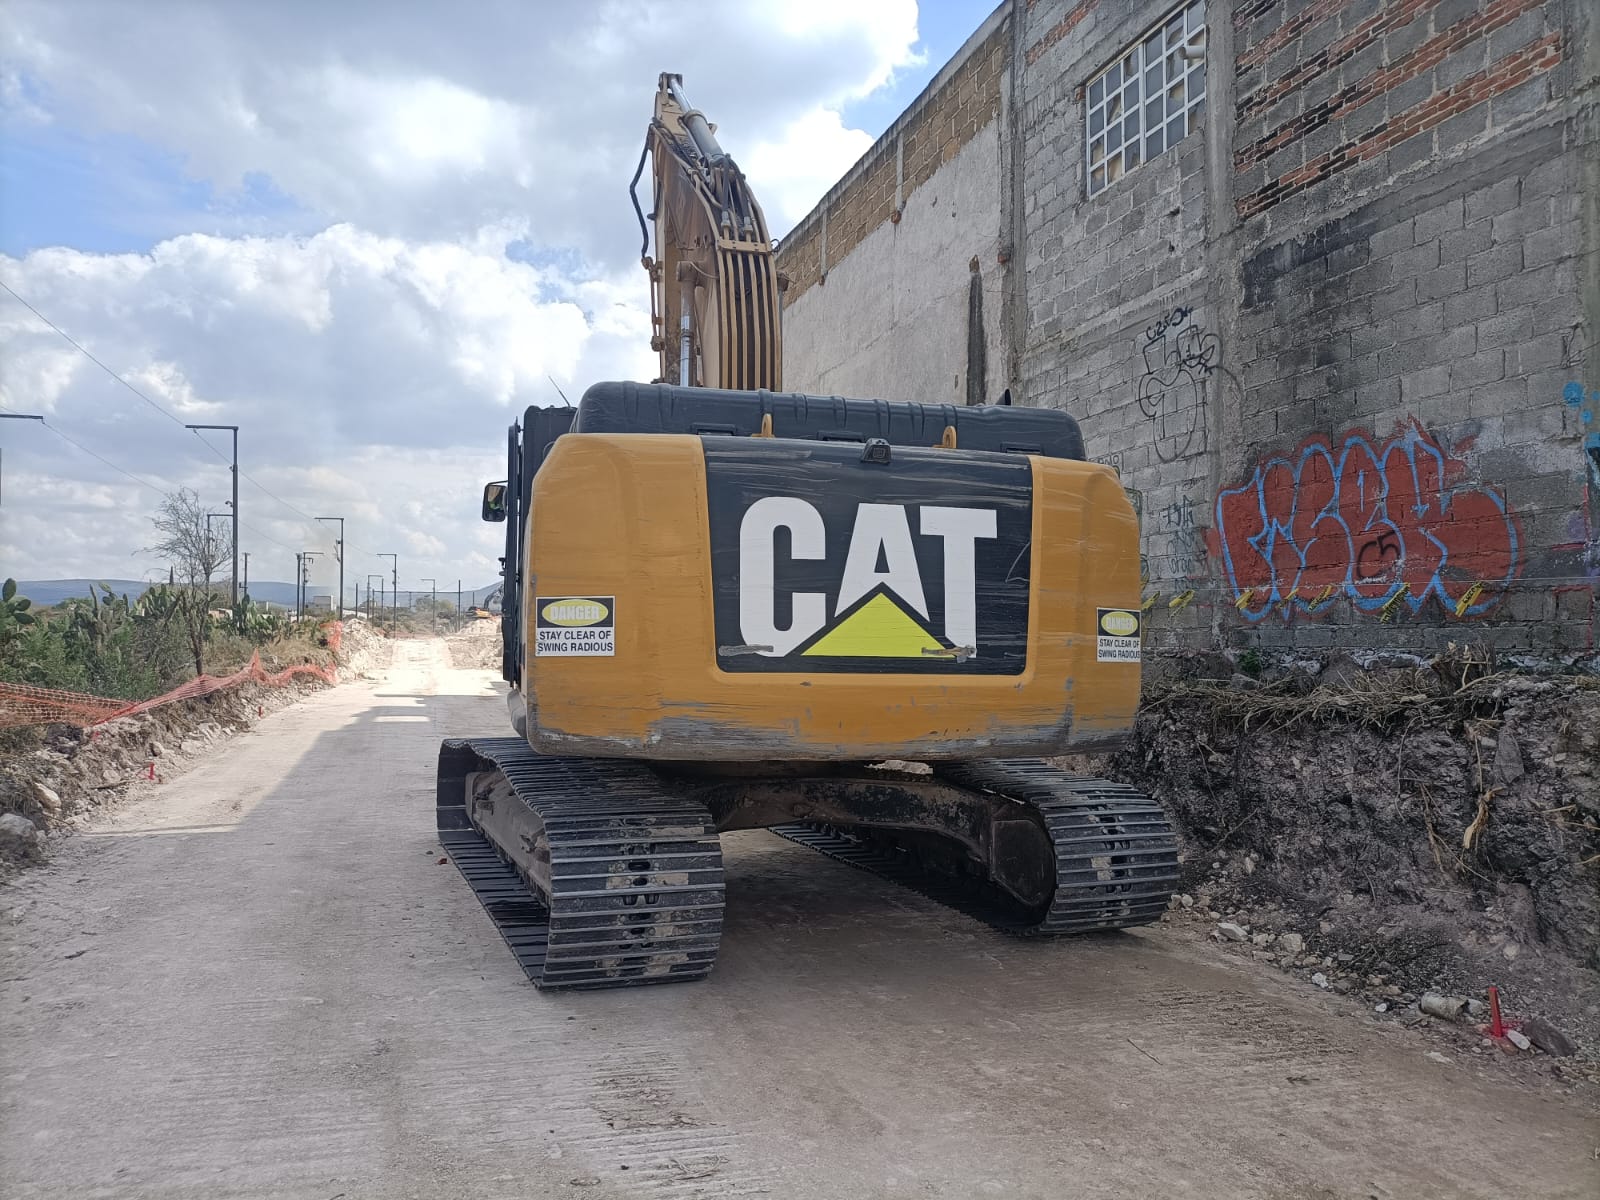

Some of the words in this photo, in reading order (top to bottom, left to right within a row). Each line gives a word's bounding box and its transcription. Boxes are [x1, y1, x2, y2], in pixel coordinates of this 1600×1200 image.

[740, 496, 997, 658] CAT
[550, 606, 600, 620] DANGER
[539, 631, 562, 640] STAY
[564, 631, 596, 640] CLEAR
[598, 630, 611, 640] OF
[538, 643, 568, 652] SWING
[570, 642, 613, 652] RADIOUS
[1099, 639, 1114, 648] STAY
[1114, 639, 1132, 648] CLEAR
[1132, 640, 1140, 648] OF
[1098, 649, 1117, 658] SWING
